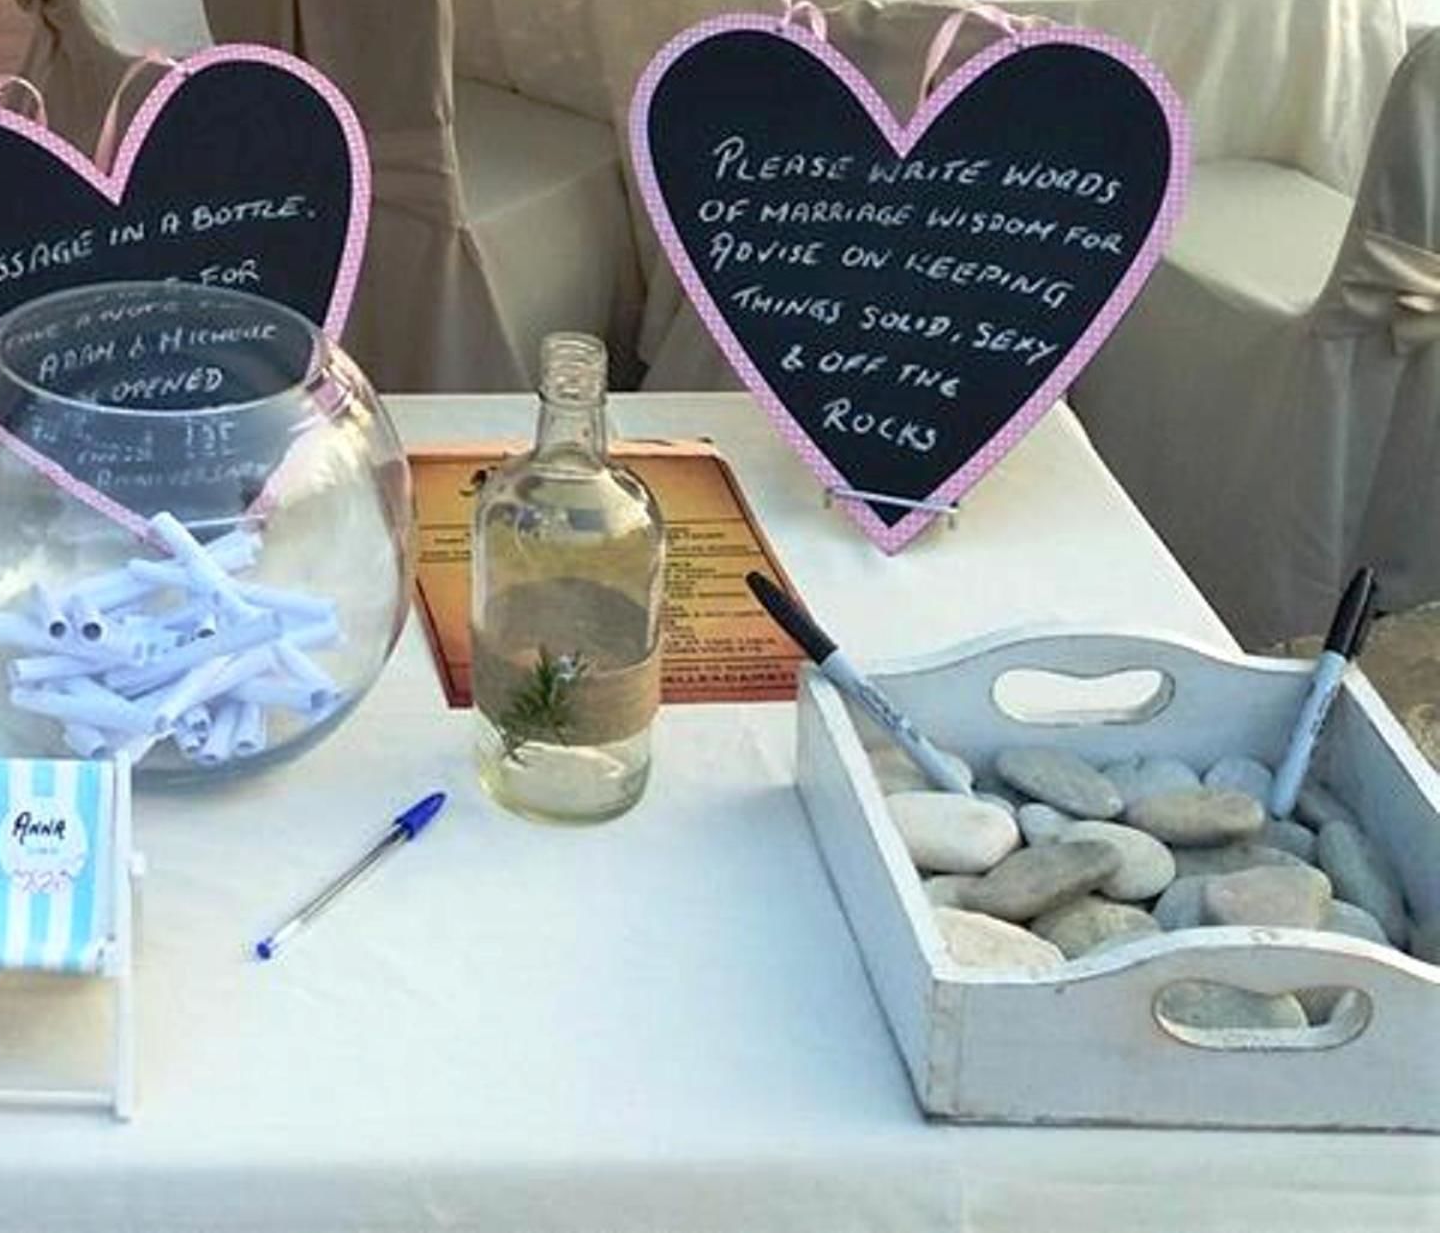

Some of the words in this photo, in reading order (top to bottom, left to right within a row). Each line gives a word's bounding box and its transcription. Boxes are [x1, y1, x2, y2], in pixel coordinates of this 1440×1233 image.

[713, 135, 854, 180] PLEASE
[868, 158, 991, 184] WRITE
[1002, 163, 1122, 203] WORDS
[110, 223, 146, 246] IN
[160, 213, 181, 234] A
[698, 199, 750, 223] OF
[760, 200, 913, 226] MARRIAGE
[926, 207, 1059, 241] WISDOM
[1063, 226, 1123, 254] FOR
[199, 259, 260, 286] FOR
[710, 231, 824, 273] ADVISE
[841, 245, 891, 268] ON
[905, 253, 1075, 308] KEEPING
[731, 285, 844, 325] THINGS
[861, 305, 962, 342] SOLID,
[973, 322, 1059, 365] SEXY
[39, 341, 116, 382] ADAM
[160, 324, 278, 353] MICHELLE
[781, 344, 804, 370] &
[818, 351, 886, 376] OFF
[900, 364, 960, 398] THE
[111, 367, 224, 404] OPENED
[822, 398, 938, 453] ROCKS
